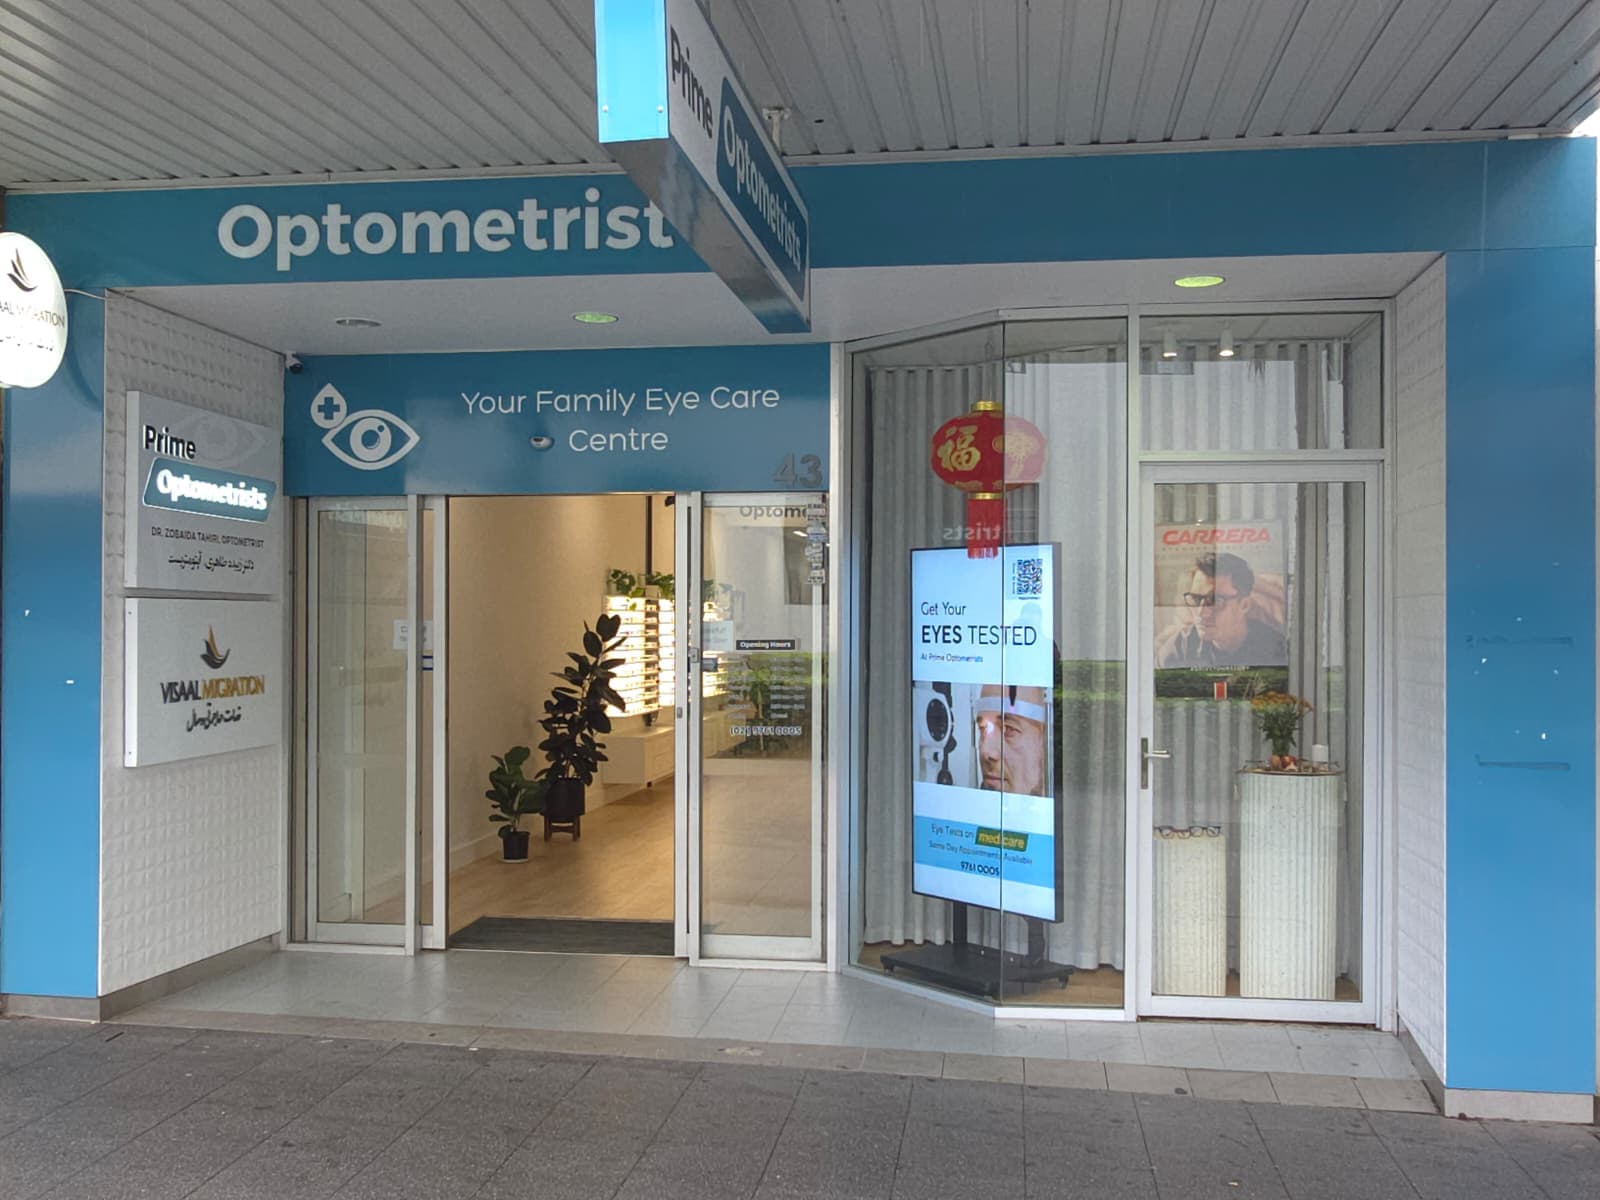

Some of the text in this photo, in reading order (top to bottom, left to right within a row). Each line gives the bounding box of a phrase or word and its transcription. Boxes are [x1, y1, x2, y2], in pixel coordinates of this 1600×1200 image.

[670, 24, 801, 271] Prime Optometrists
[217, 186, 674, 272] Optometrist
[461, 386, 780, 417] Your Family Eye Care
[143, 424, 196, 460] Prime
[568, 427, 668, 452] Centre
[937, 425, 981, 472] 福
[773, 452, 823, 488] 43
[156, 468, 268, 510] Optometrists
[1162, 527, 1271, 545] CARRERA
[920, 601, 967, 616] Get Your
[740, 641, 769, 649] Opening
[922, 625, 1037, 646] EYES TESTED
[929, 653, 945, 662] Prime
[160, 675, 265, 704] VISAAL MIGRATION
[931, 823, 944, 835] Eye
[978, 831, 1025, 849] medicare
[960, 861, 1000, 876] 9761 0005
